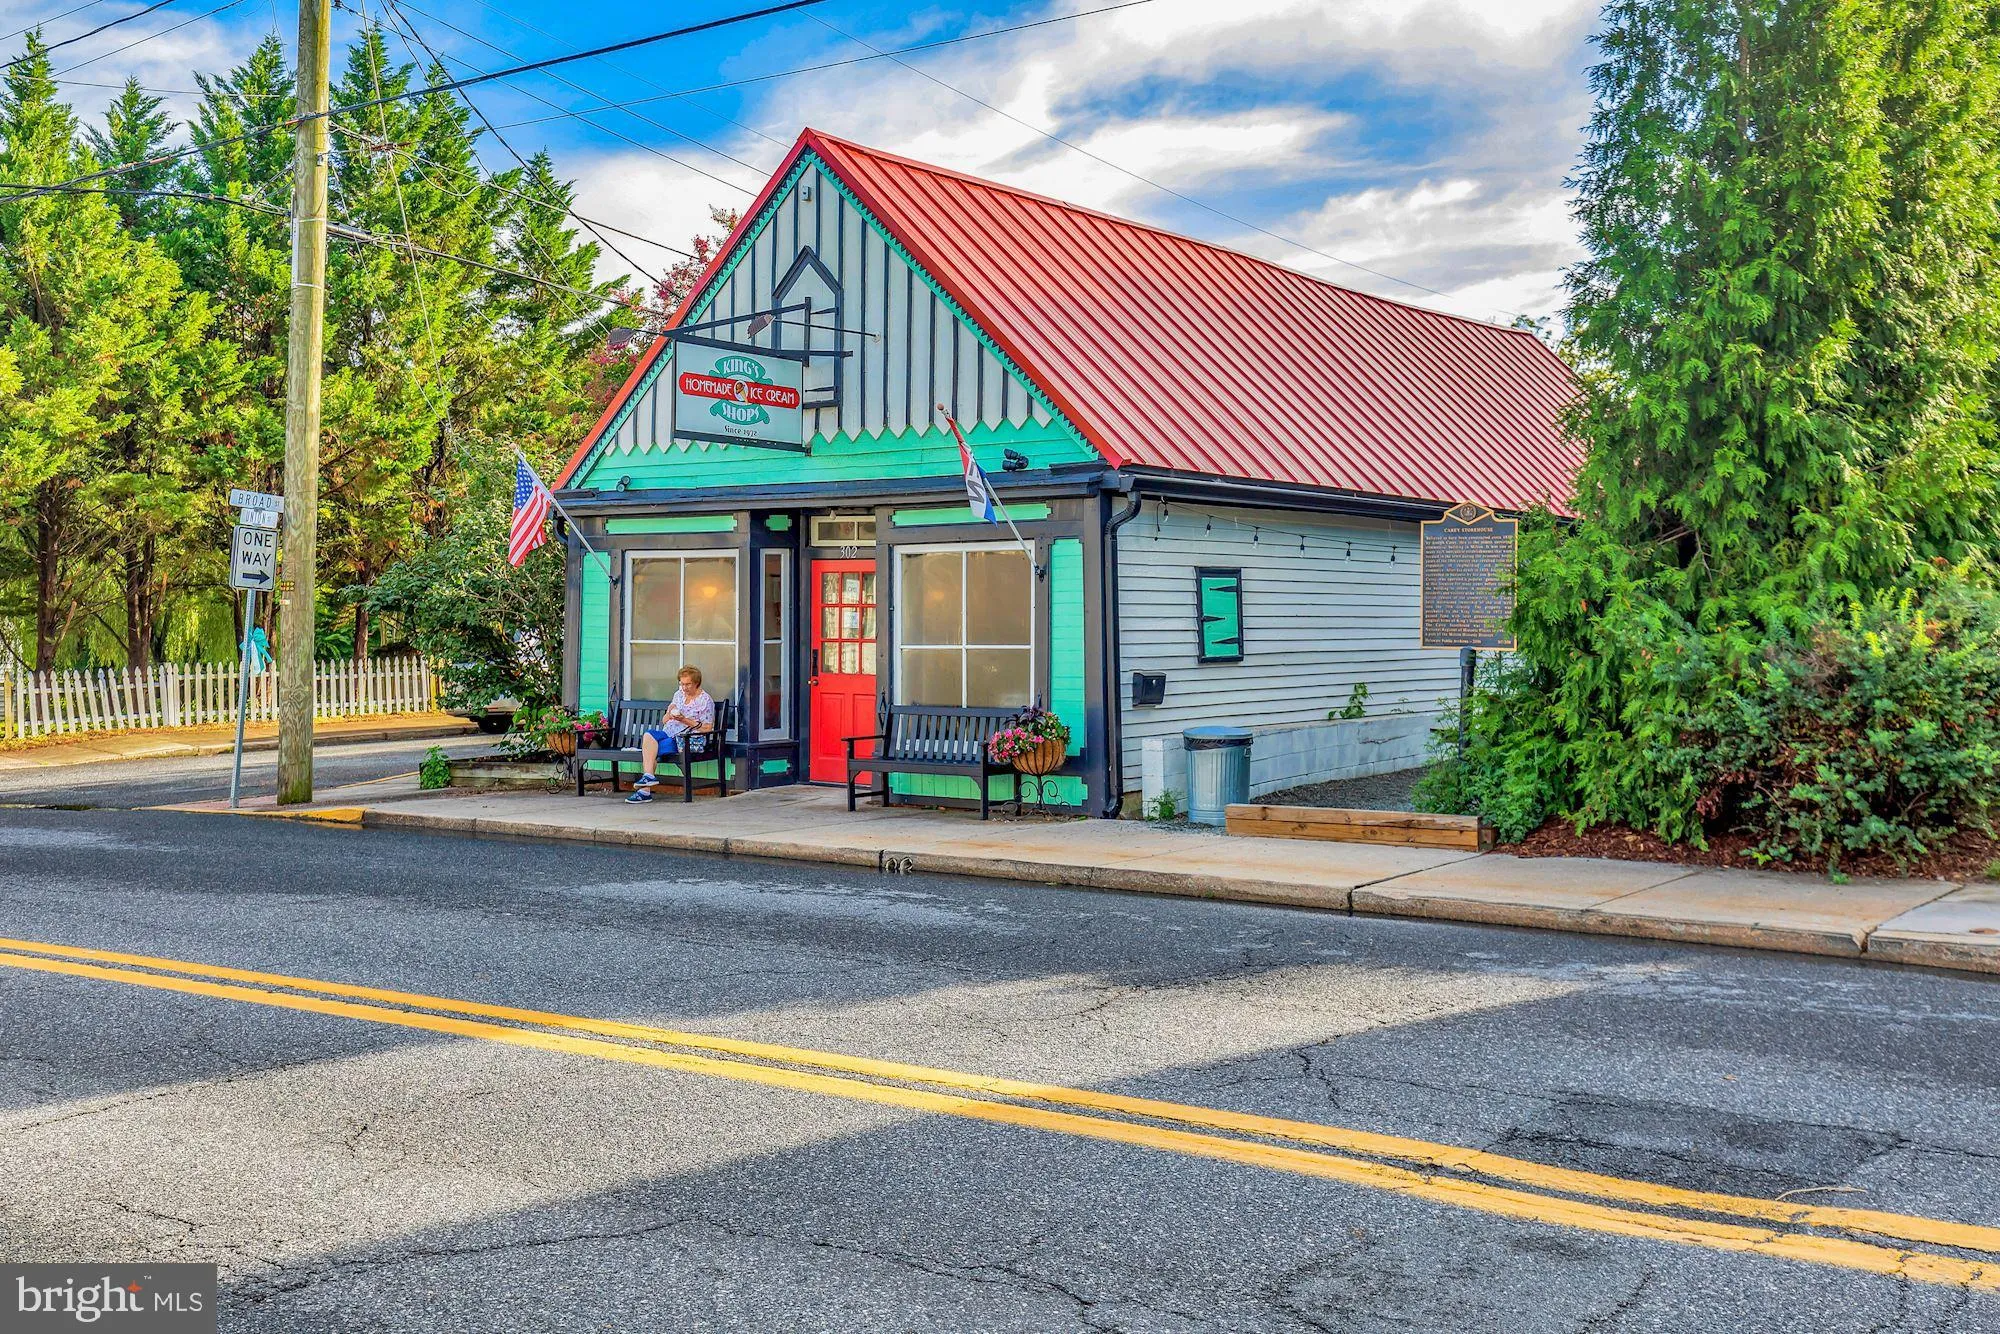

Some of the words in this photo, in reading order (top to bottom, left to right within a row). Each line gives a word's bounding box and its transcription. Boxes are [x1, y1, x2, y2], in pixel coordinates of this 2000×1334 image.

[723, 359, 760, 379] KING'S
[685, 378, 732, 395] HOMEMADE
[750, 387, 763, 400] ICE
[765, 389, 795, 404] CREAM
[722, 403, 760, 421] SHOPS
[724, 425, 742, 435] Since
[238, 494, 271, 508] BROAD
[246, 511, 266, 523] UNION
[243, 531, 272, 547] ONE
[242, 550, 271, 566] WAY
[840, 546, 858, 559] 302
